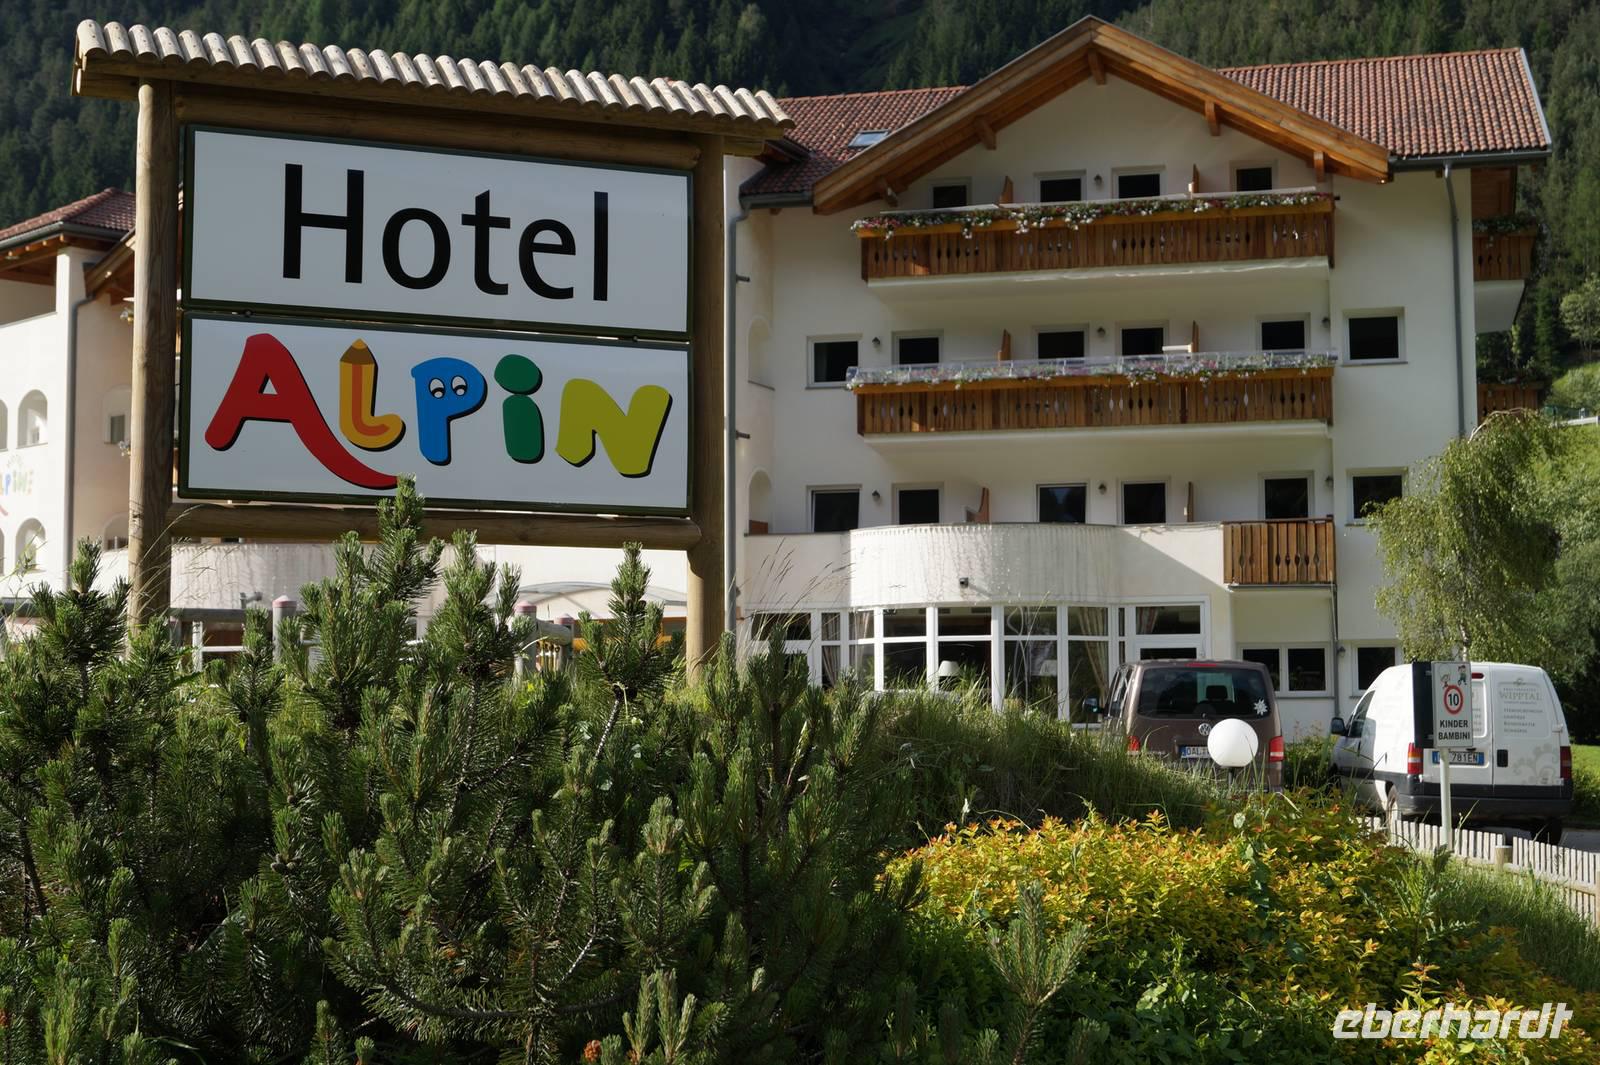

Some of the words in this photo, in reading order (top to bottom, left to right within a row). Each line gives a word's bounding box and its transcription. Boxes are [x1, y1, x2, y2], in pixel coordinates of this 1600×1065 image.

[283, 163, 608, 302] Hotel
[1448, 693, 1459, 706] 10
[1440, 720, 1469, 728] KINDER
[1438, 732, 1471, 740] BAMBINI
